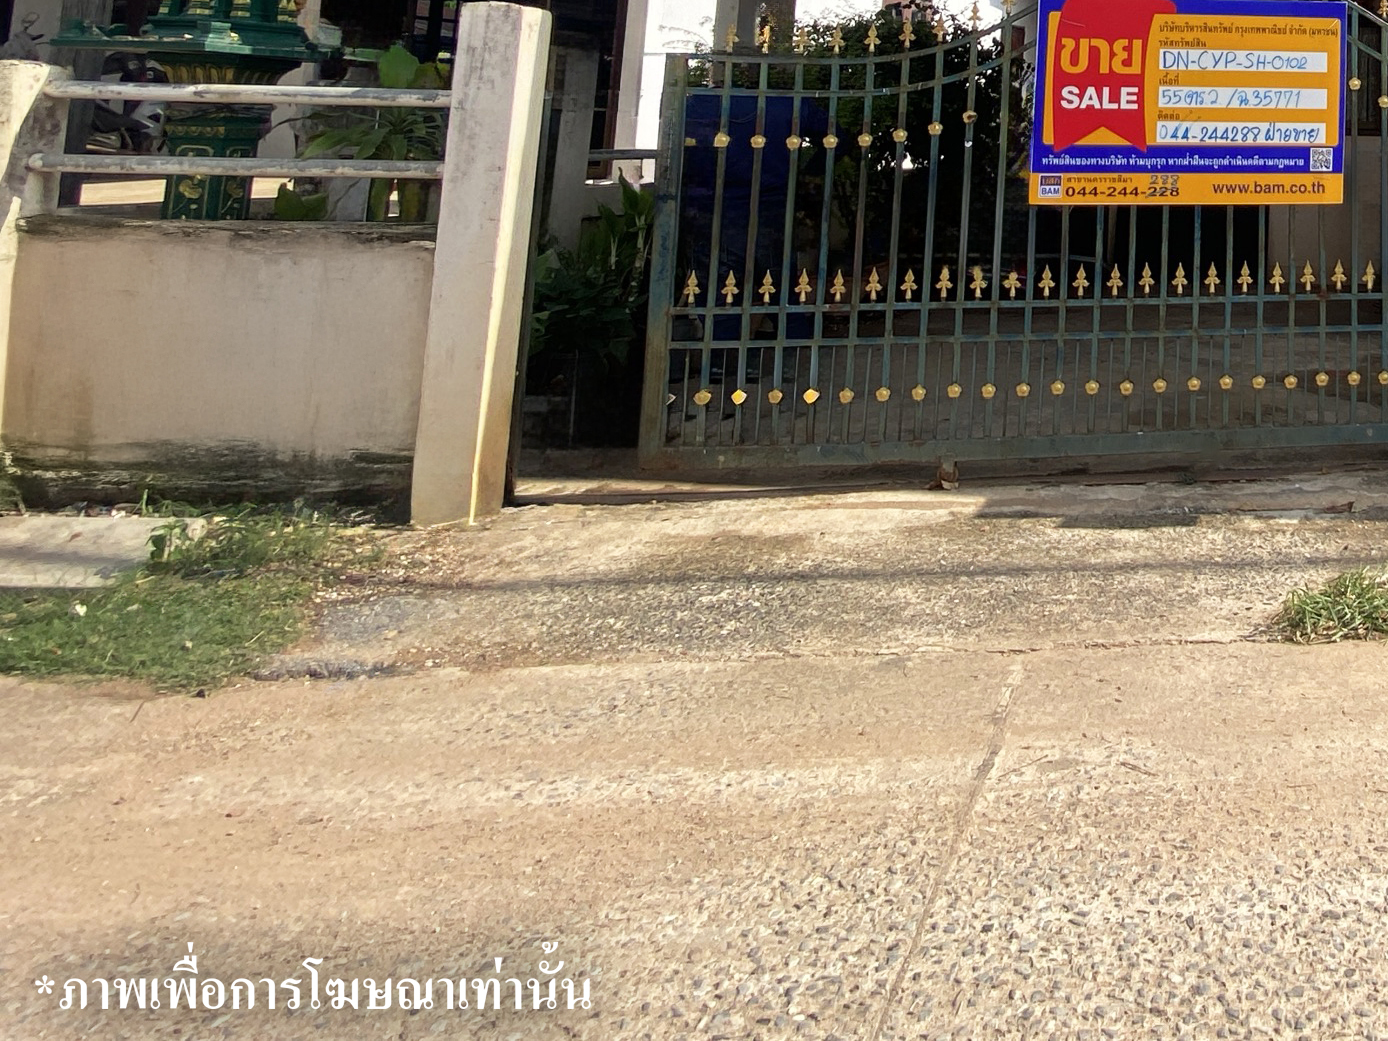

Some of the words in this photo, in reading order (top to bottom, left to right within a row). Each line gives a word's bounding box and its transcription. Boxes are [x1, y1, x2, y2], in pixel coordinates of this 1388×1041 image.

[1159, 21, 1233, 34] บริษัทบริหารสินทรัพย์
[1234, 23, 1287, 38] กรุงเทพพาณิชย์
[1289, 25, 1307, 35] จำกัด
[1060, 37, 1143, 74] ขาย
[1162, 50, 1308, 70] DN-CYP-SH-0102
[1158, 72, 1180, 85] เนื้อที่
[1060, 85, 1139, 110] SALE
[1157, 110, 1180, 121] ติดต่อ
[1159, 124, 1261, 143] 044-244288
[1042, 154, 1127, 166] ทรัพย์สินของทางบริษัท
[1129, 154, 1166, 169] ห้ามบุกรุก
[1041, 186, 1060, 196] BAM
[1212, 180, 1326, 195] www.bam.co.th
